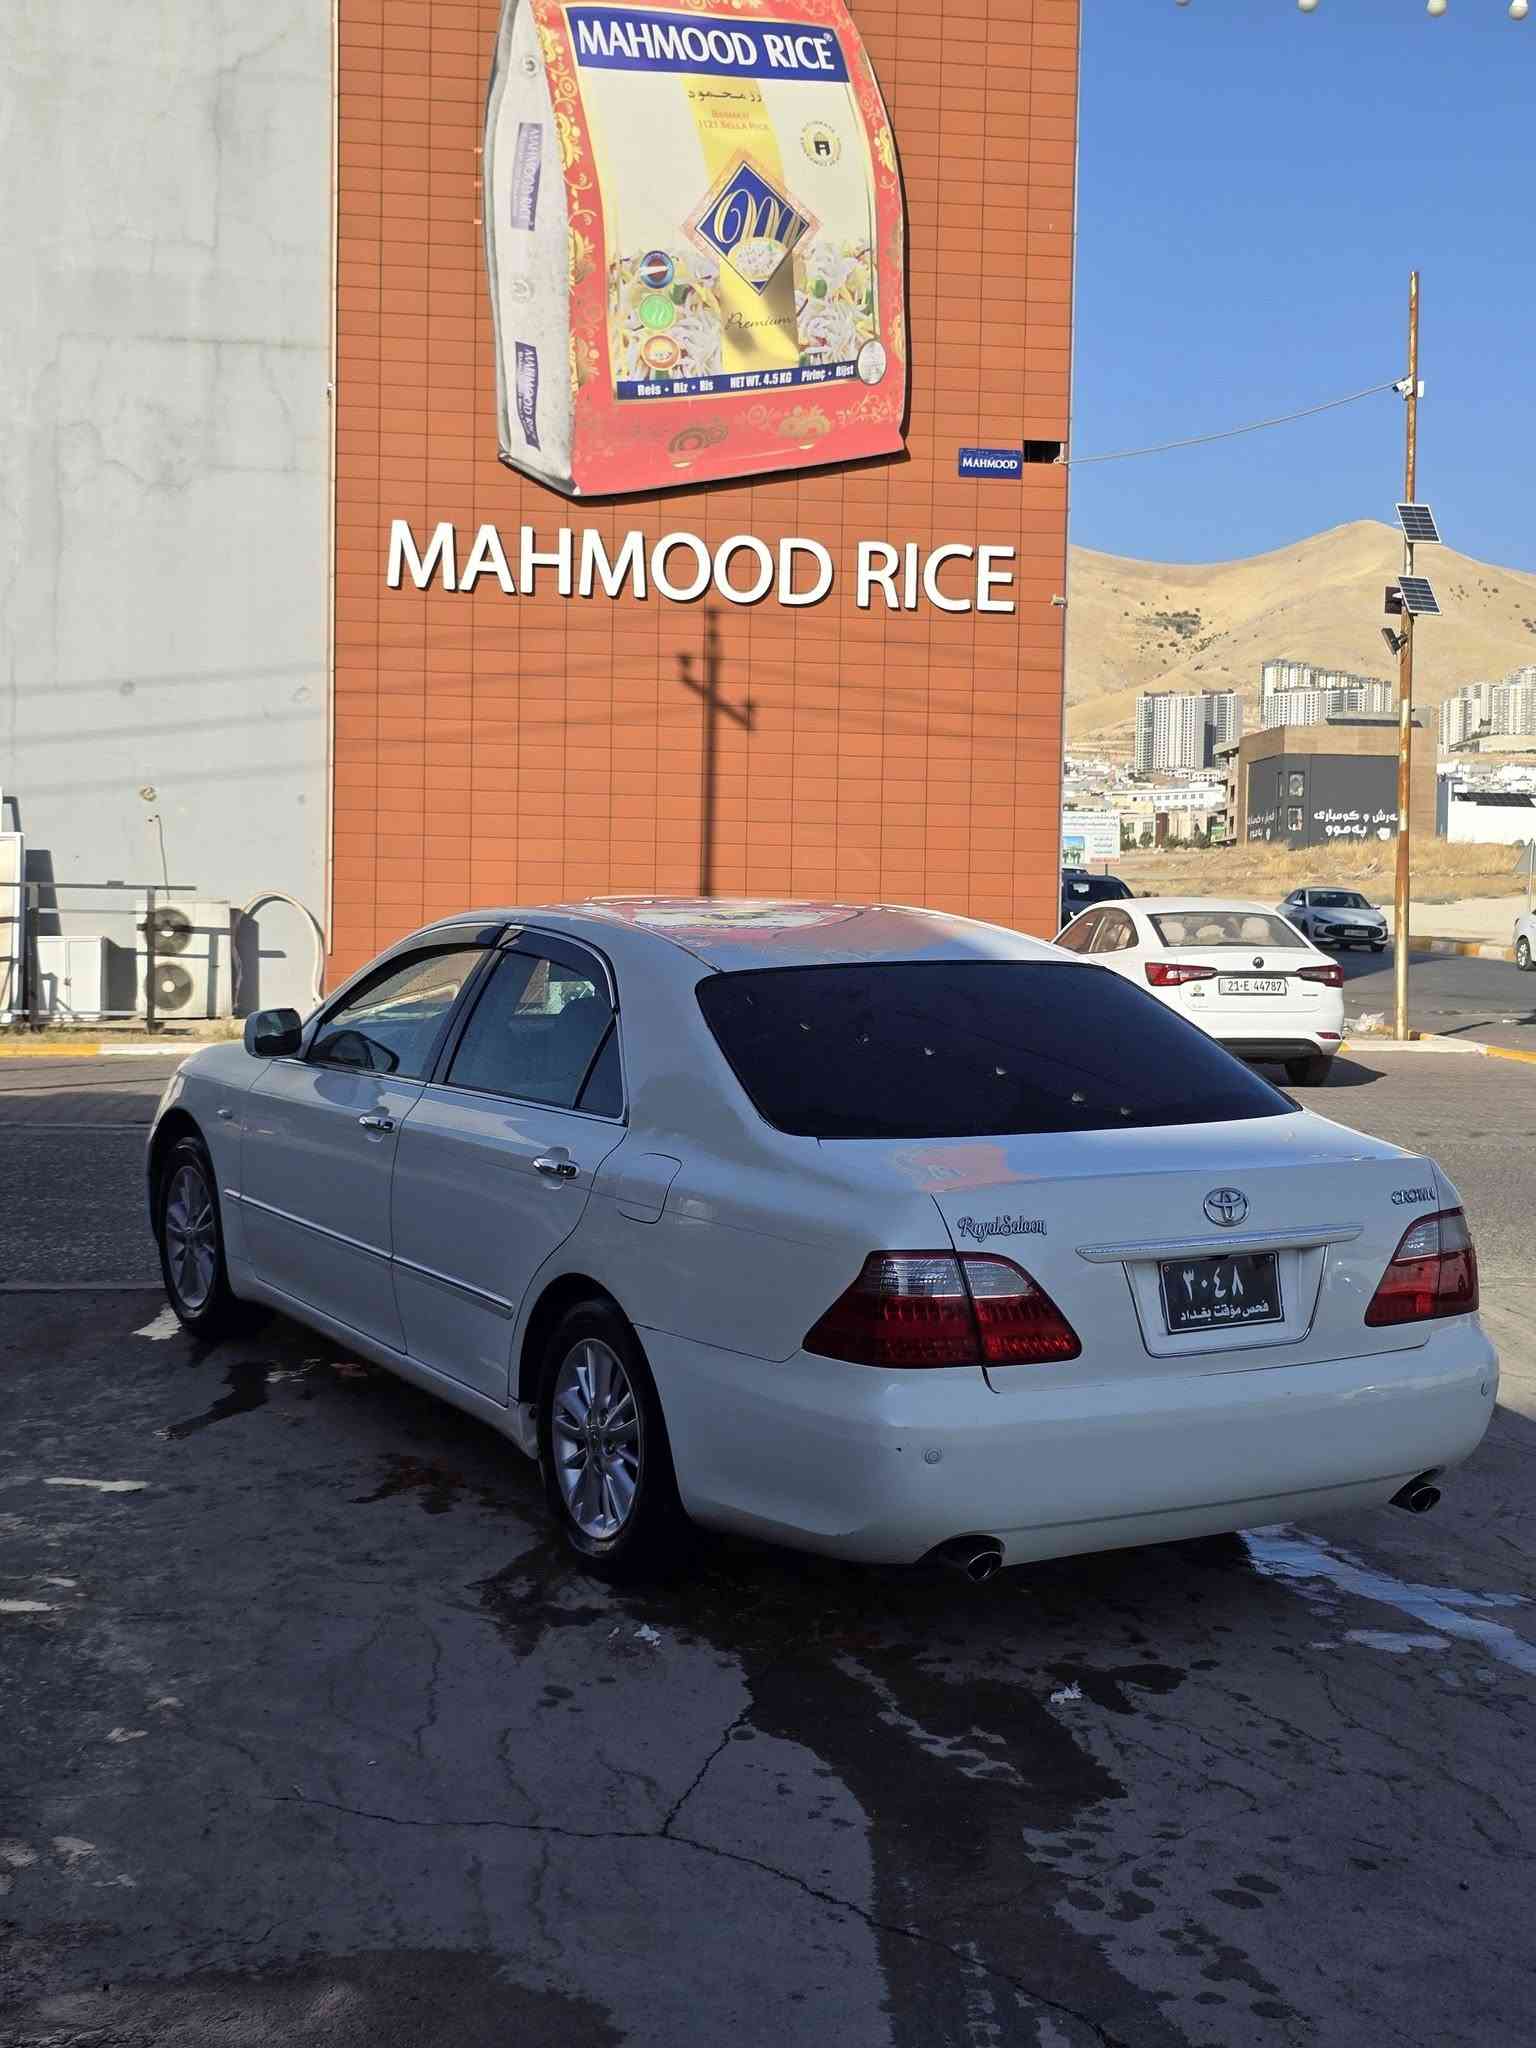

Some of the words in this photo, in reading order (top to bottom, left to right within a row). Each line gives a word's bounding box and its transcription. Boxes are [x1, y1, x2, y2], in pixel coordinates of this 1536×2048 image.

[578, 20, 757, 66] MAHMOOD
[724, 312, 793, 331] Premium
[637, 381, 661, 396] Reis
[673, 381, 689, 395] Riz
[730, 376, 745, 389] NET
[763, 373, 779, 385] 4.5
[779, 371, 792, 384] KG
[962, 457, 1018, 470] MAHMOOD
[385, 519, 834, 606] MAHMOOD
[855, 540, 1017, 614] RICE
[1253, 980, 1283, 992] 44787
[1391, 1187, 1437, 1206] CROWN
[1180, 1306, 1212, 1322] بغداد
[1213, 1303, 1241, 1319] مؤقت
[1242, 1300, 1270, 1318] فحص
